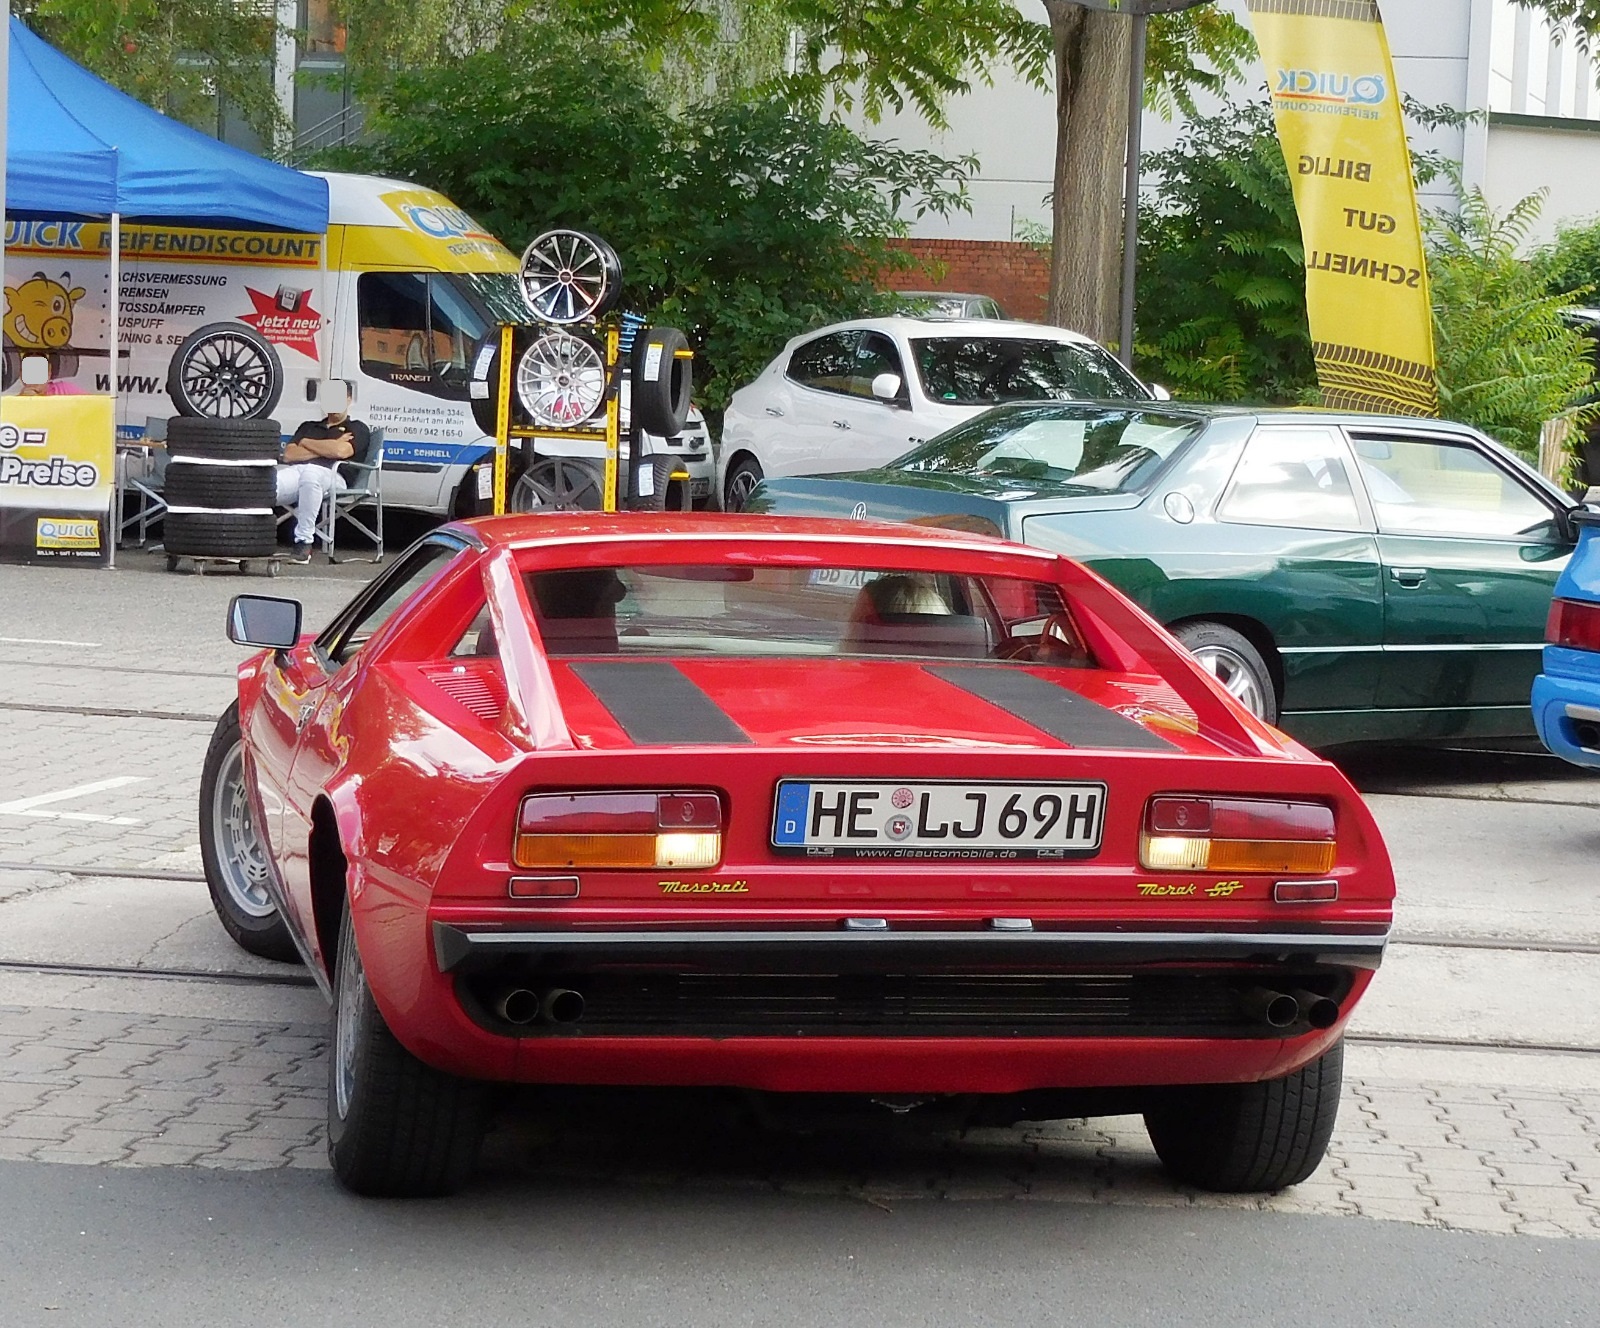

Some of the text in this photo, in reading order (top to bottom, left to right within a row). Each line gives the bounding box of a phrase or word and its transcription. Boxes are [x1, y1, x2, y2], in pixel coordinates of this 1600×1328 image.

[5, 221, 321, 258] UICK REIFENDISCOUNT
[118, 271, 228, 287] CHSVERMESSUNG
[119, 286, 170, 299] REMSEN
[118, 301, 206, 316] TOSSDÄMPFER
[117, 316, 165, 329] USPUFF
[256, 315, 322, 330] Jetzt neu!
[117, 331, 152, 345] UNING
[389, 372, 433, 383] TRANSIT
[387, 447, 452, 458] GUT SCHNELL
[0, 456, 97, 487] Preise
[40, 522, 95, 538] QUICK
[784, 791, 1097, 840] D HE LJ 69H
[658, 881, 749, 893] Maserati
[1137, 881, 1244, 897] Merak SS
